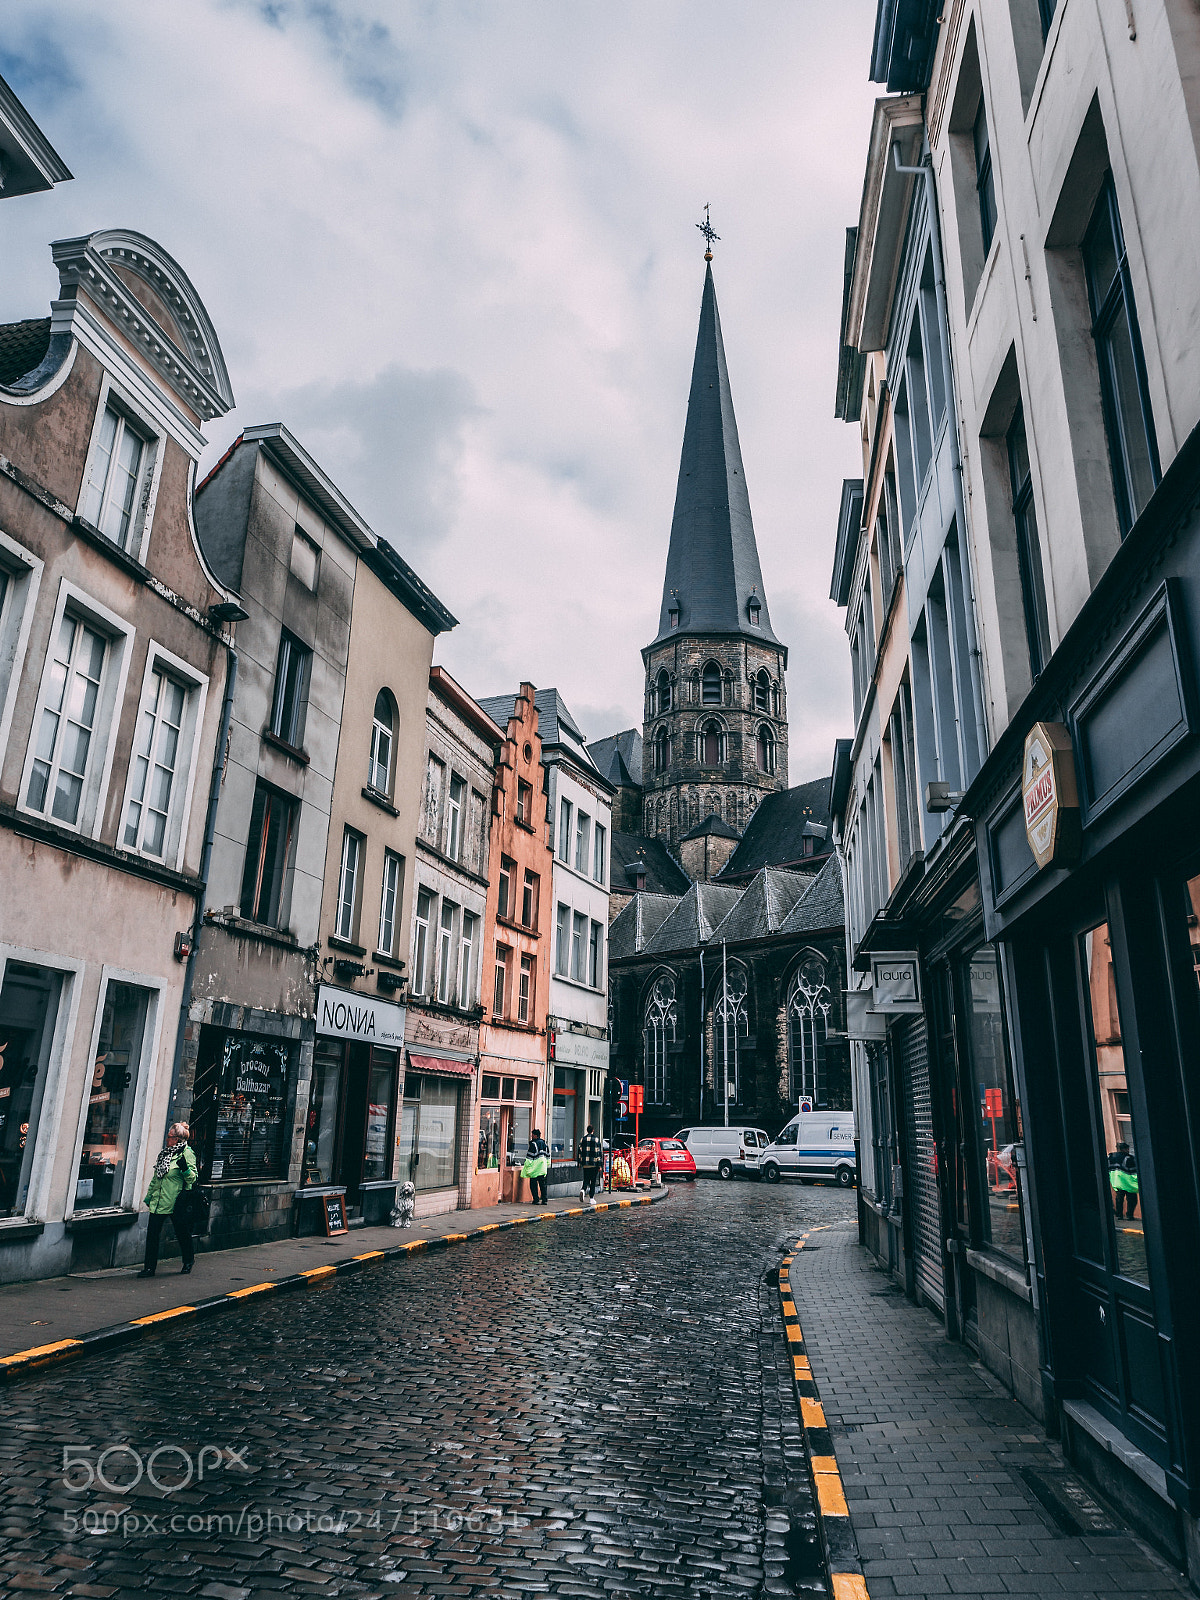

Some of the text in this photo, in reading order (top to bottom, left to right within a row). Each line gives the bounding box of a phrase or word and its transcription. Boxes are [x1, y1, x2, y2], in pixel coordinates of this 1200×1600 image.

[1026, 770, 1052, 818] PRIMUS
[880, 970, 912, 981] laura
[240, 1059, 271, 1078] brocant
[236, 1076, 271, 1094] Balthazar
